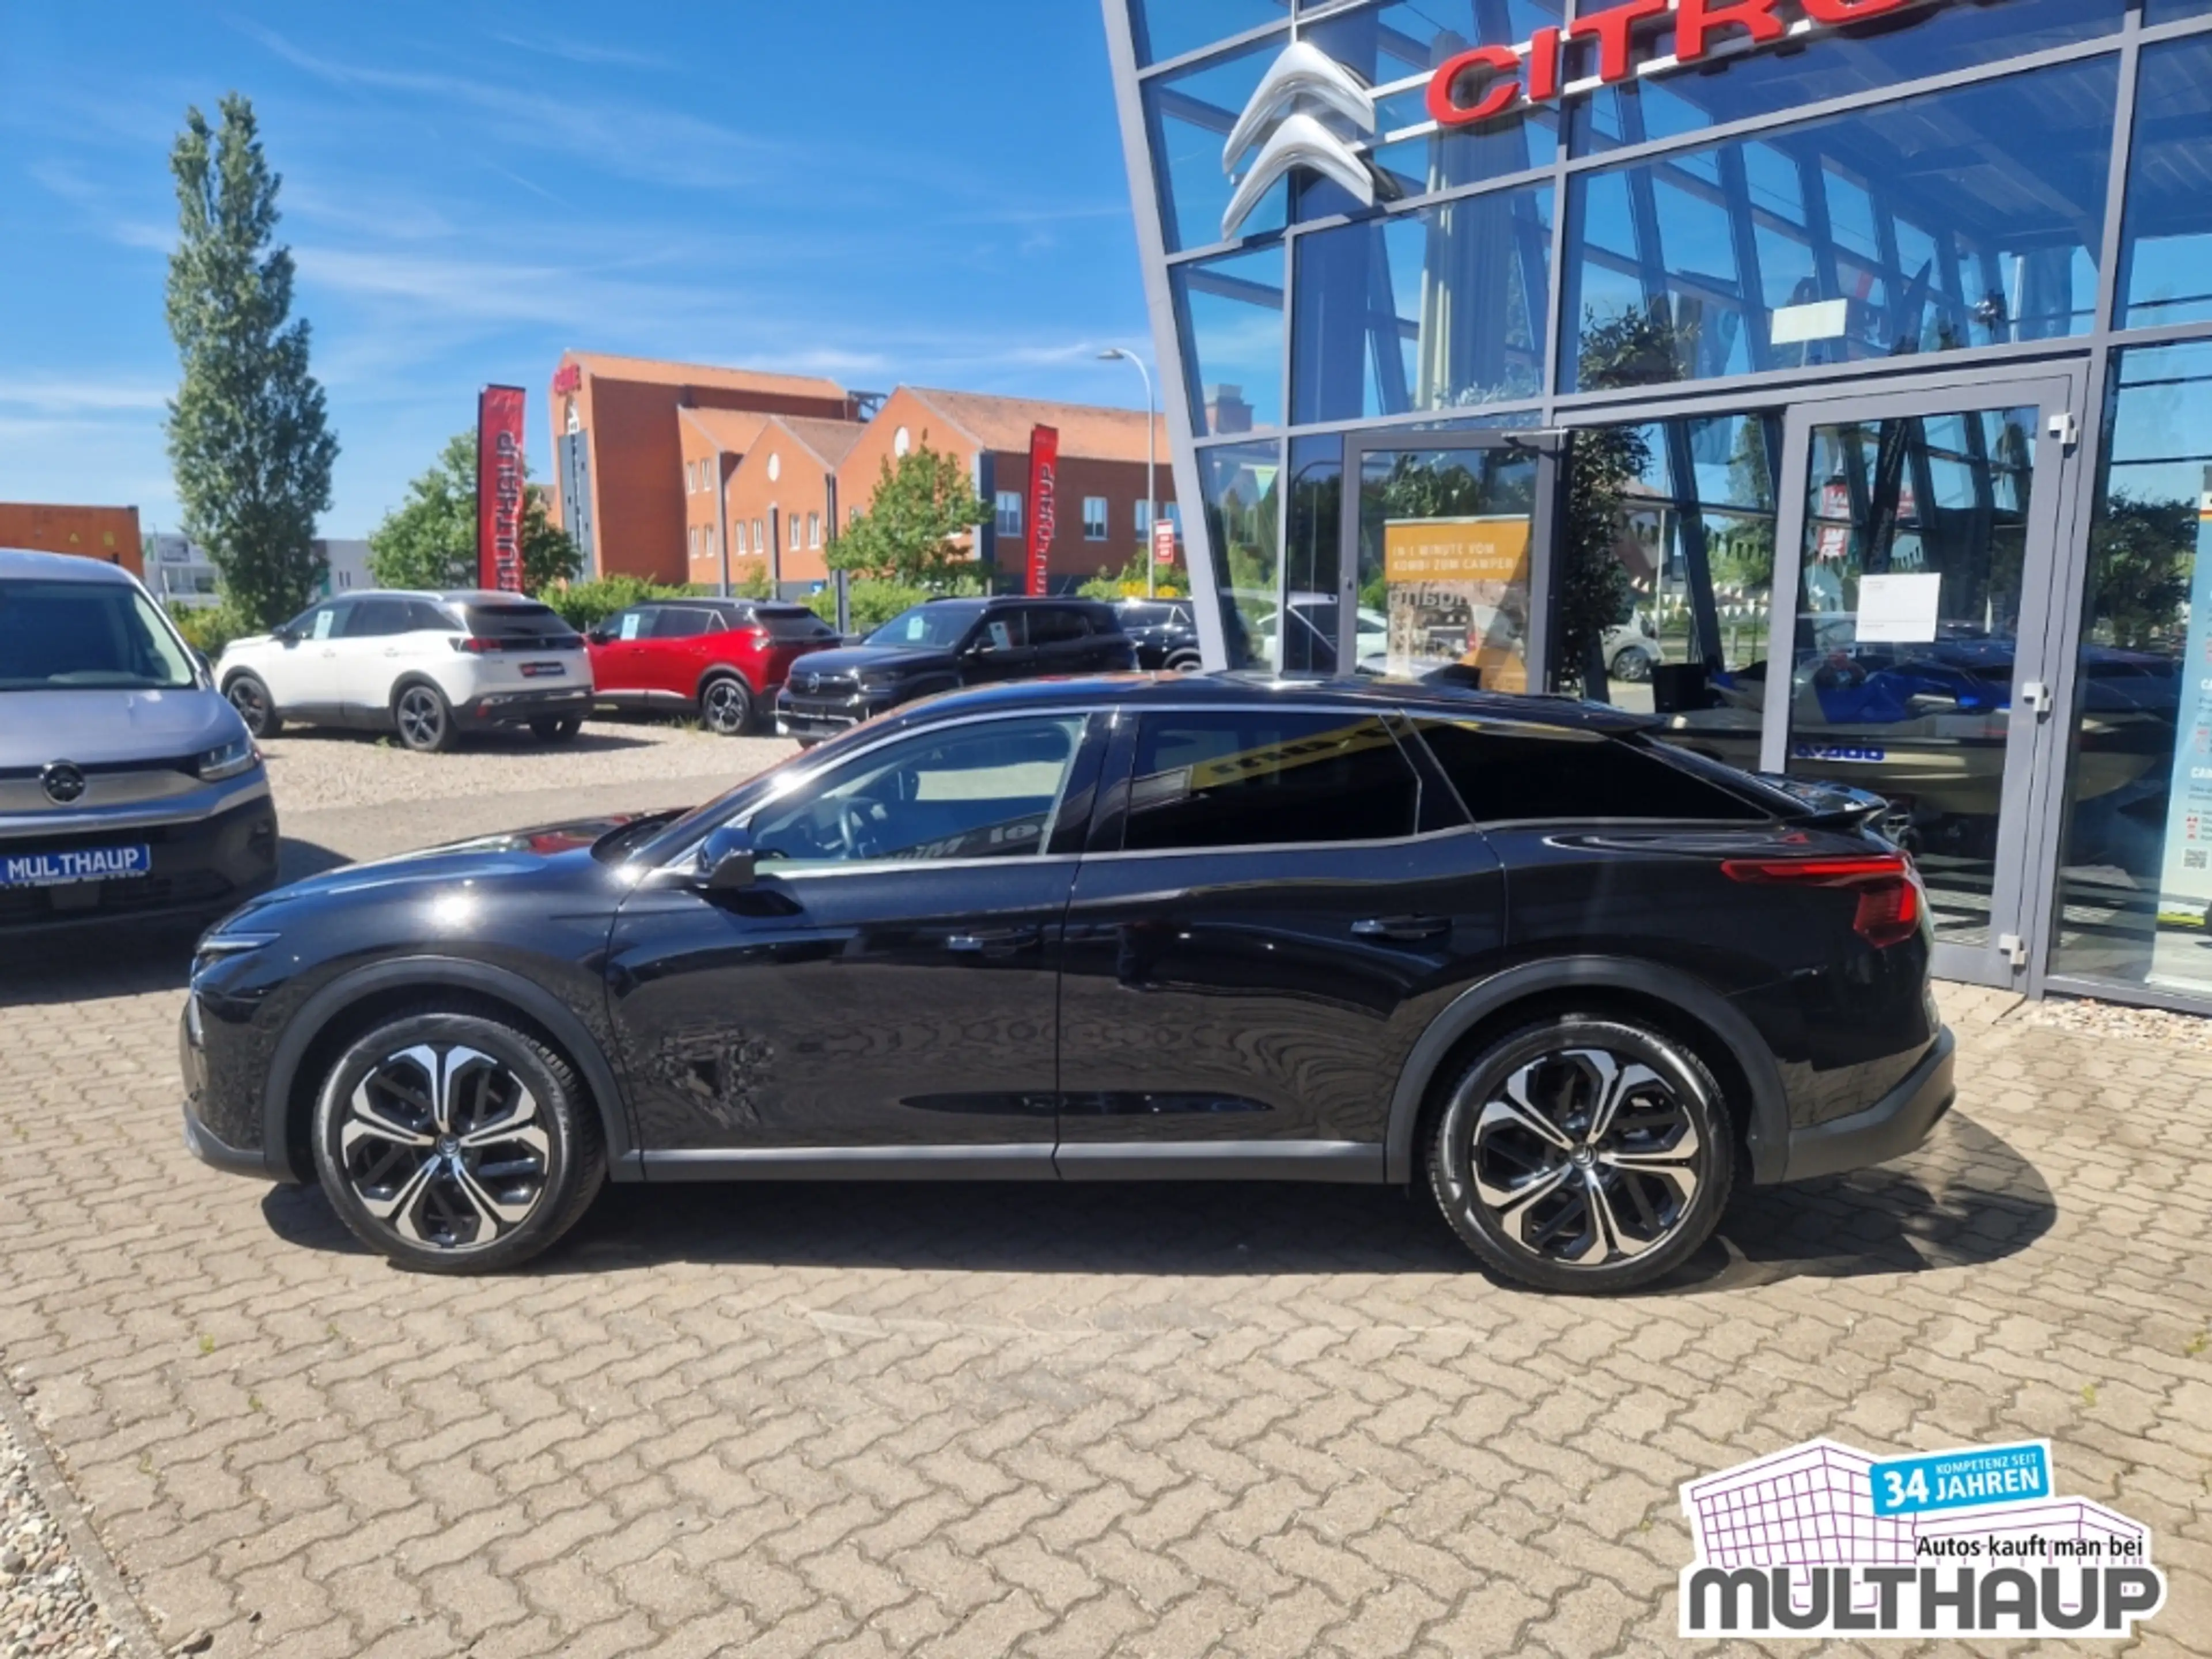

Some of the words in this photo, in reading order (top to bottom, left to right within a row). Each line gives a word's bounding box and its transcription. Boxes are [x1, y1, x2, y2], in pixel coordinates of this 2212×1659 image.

[1419, 544, 1464, 556] MINUTE
[1469, 542, 1495, 554] VOM
[1434, 558, 1459, 570] ZUM
[1463, 556, 1514, 569] CAMPER
[7, 848, 139, 880] MULTHAUP
